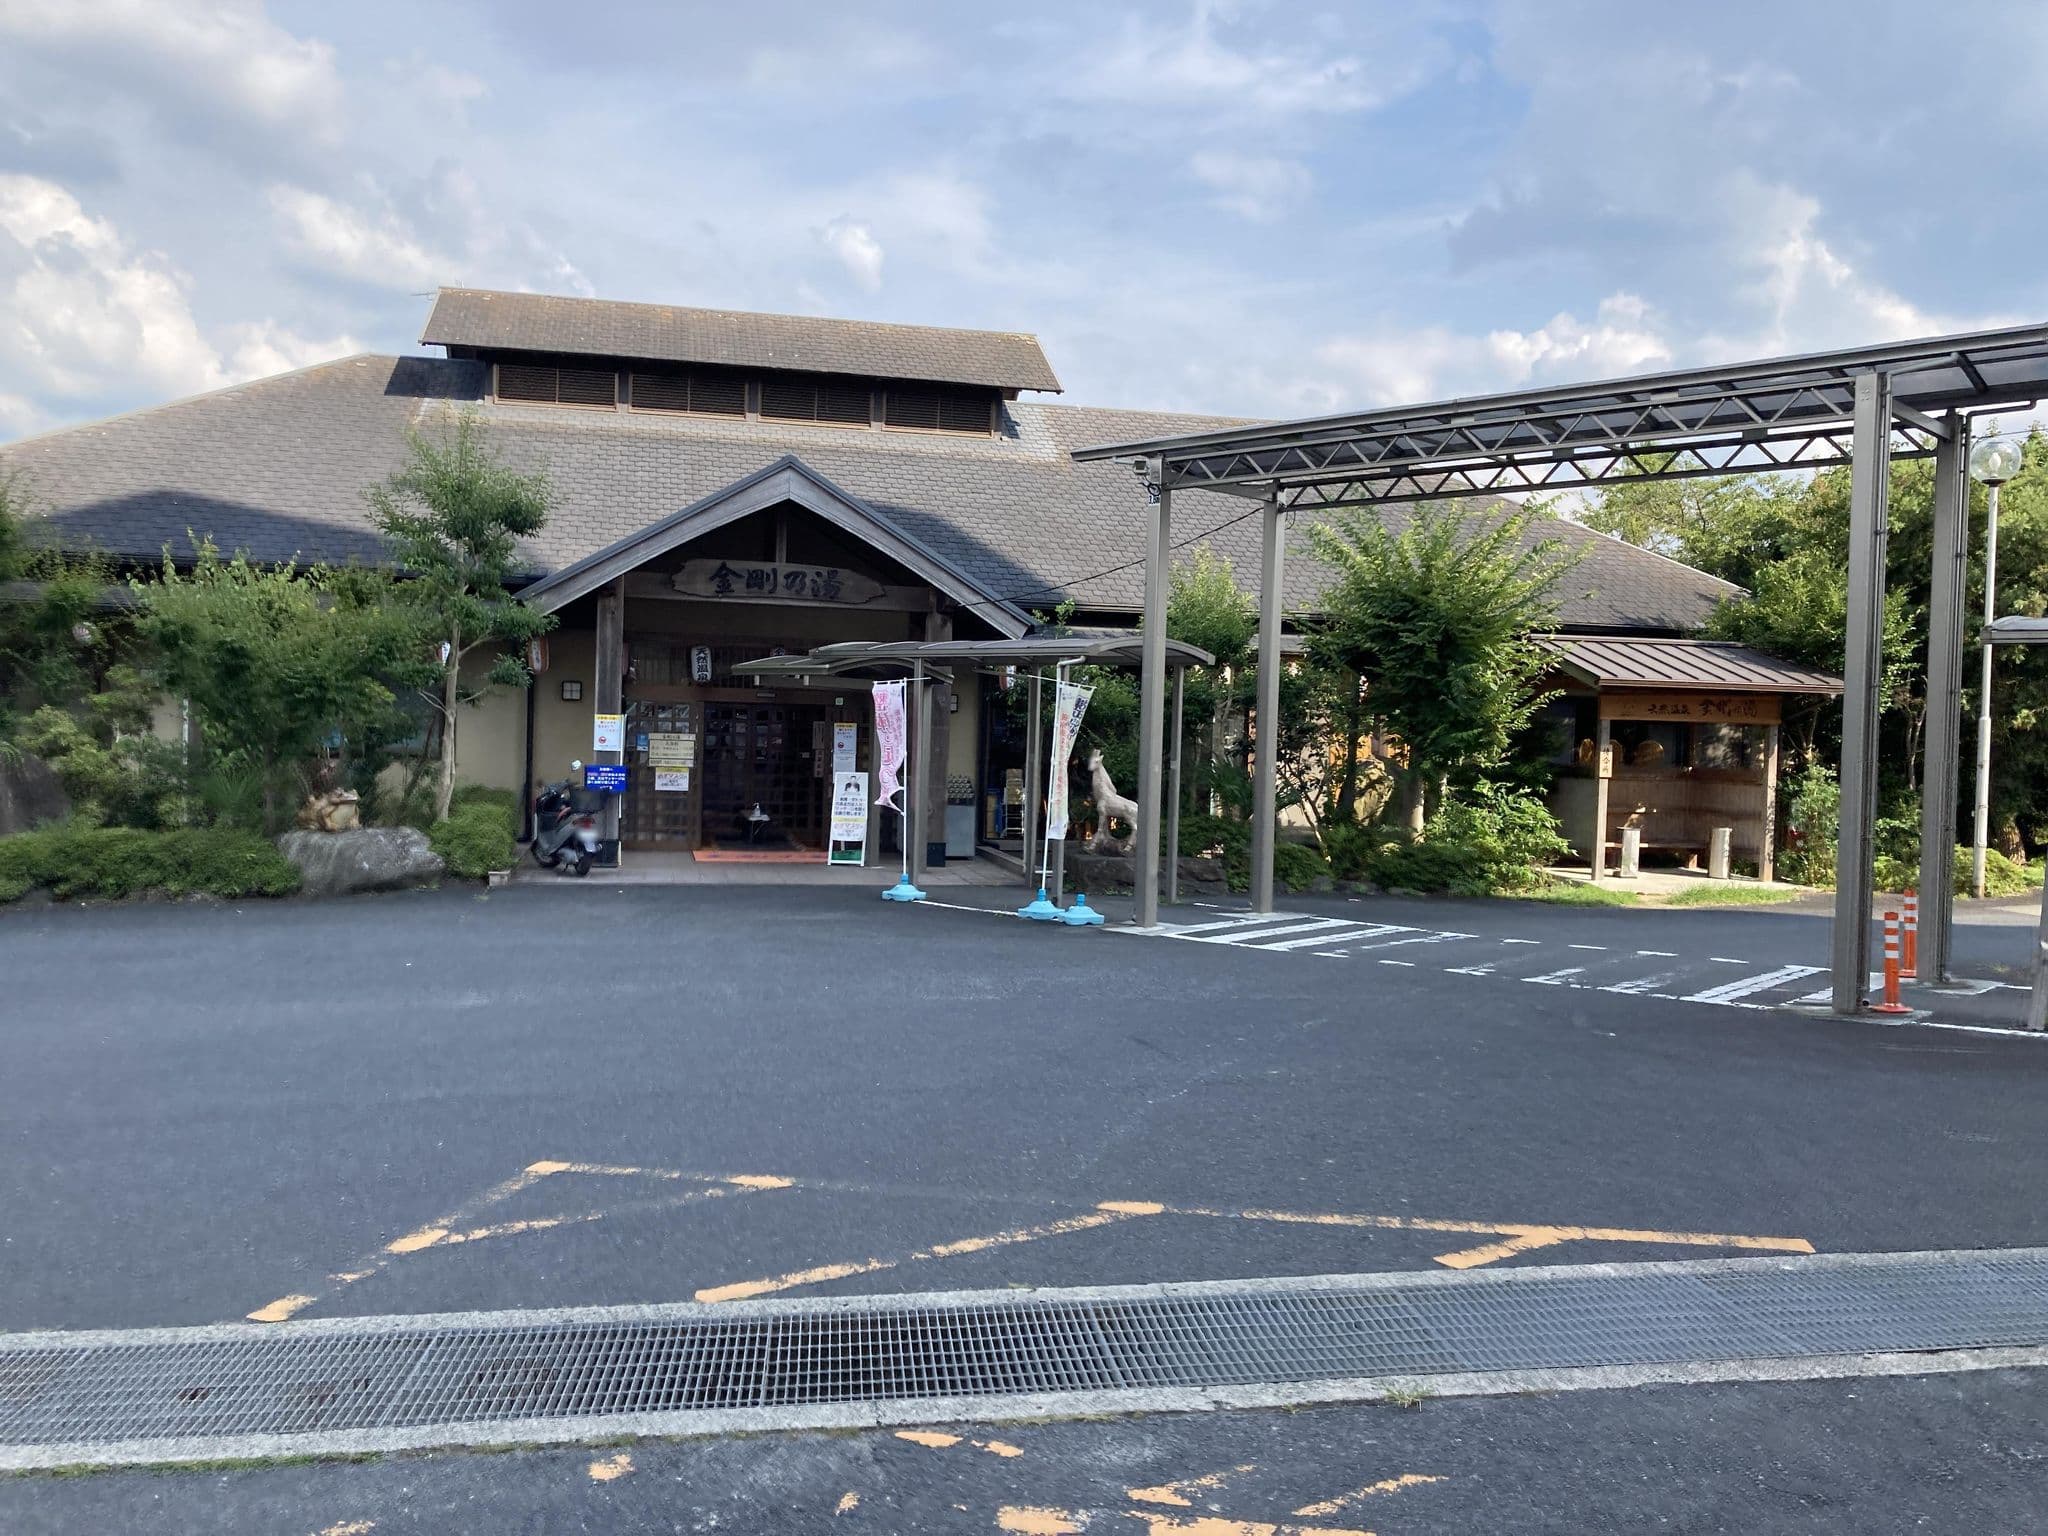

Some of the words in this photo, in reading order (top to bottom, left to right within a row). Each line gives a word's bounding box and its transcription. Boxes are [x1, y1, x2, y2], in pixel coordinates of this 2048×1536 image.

[709, 560, 844, 600] 金剛乃湯
[696, 647, 709, 681] 天然温泉
[1648, 703, 1691, 715] 天然温泉
